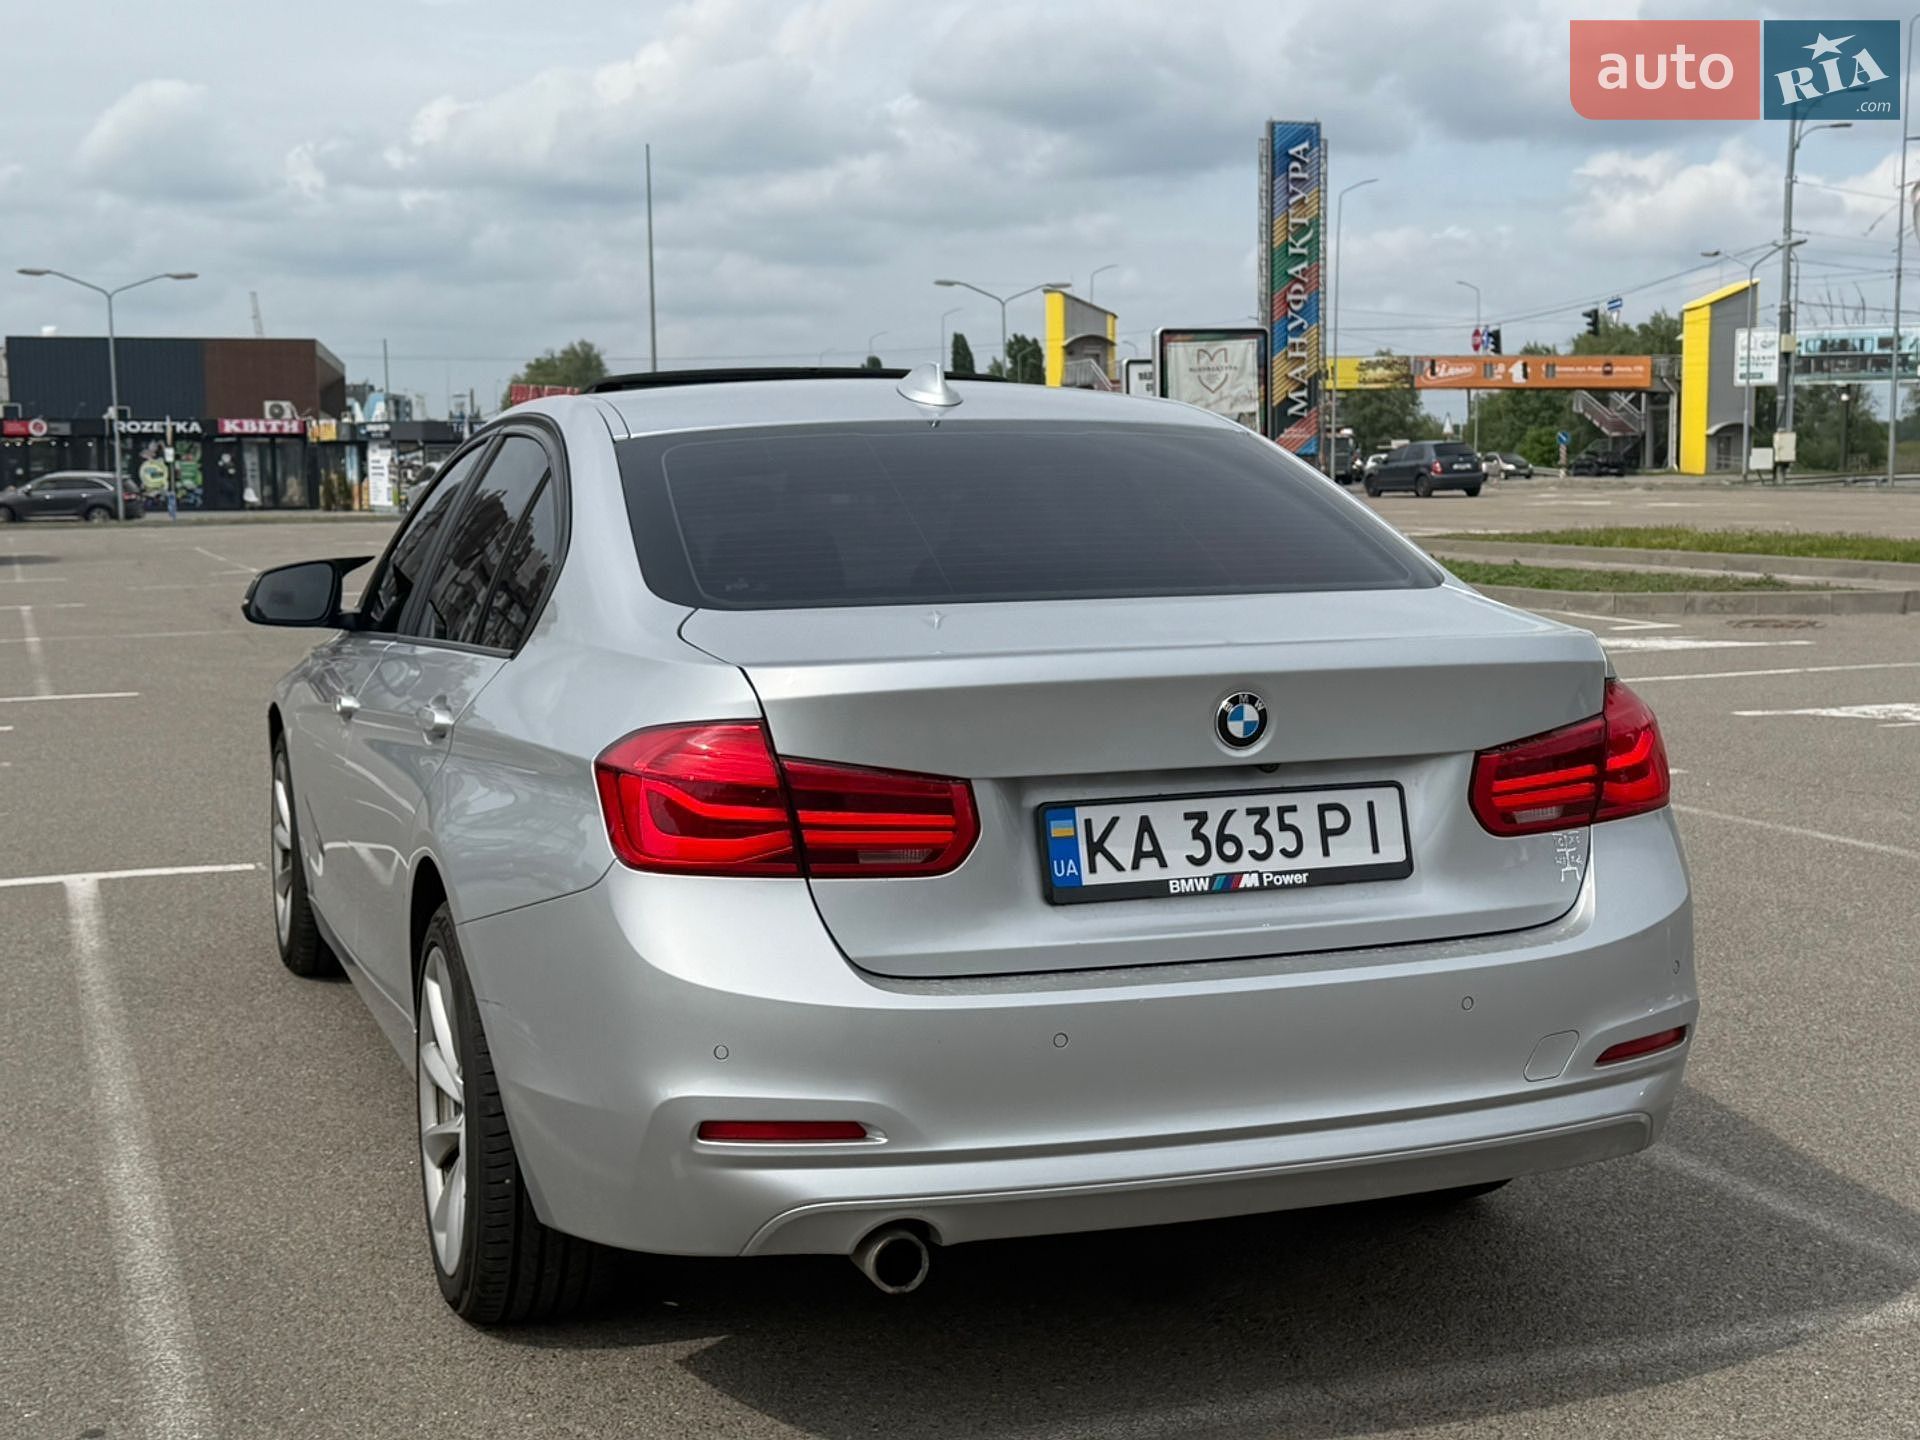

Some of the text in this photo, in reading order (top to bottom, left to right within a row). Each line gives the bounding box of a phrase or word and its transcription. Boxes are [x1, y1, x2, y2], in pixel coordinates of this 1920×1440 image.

[1286, 140, 1313, 417] МАНУФАКТУРА
[1184, 805, 1304, 865] 3635
[1053, 859, 1079, 878] UA
[1169, 876, 1210, 894] BMW
[1262, 870, 1309, 887] Power
